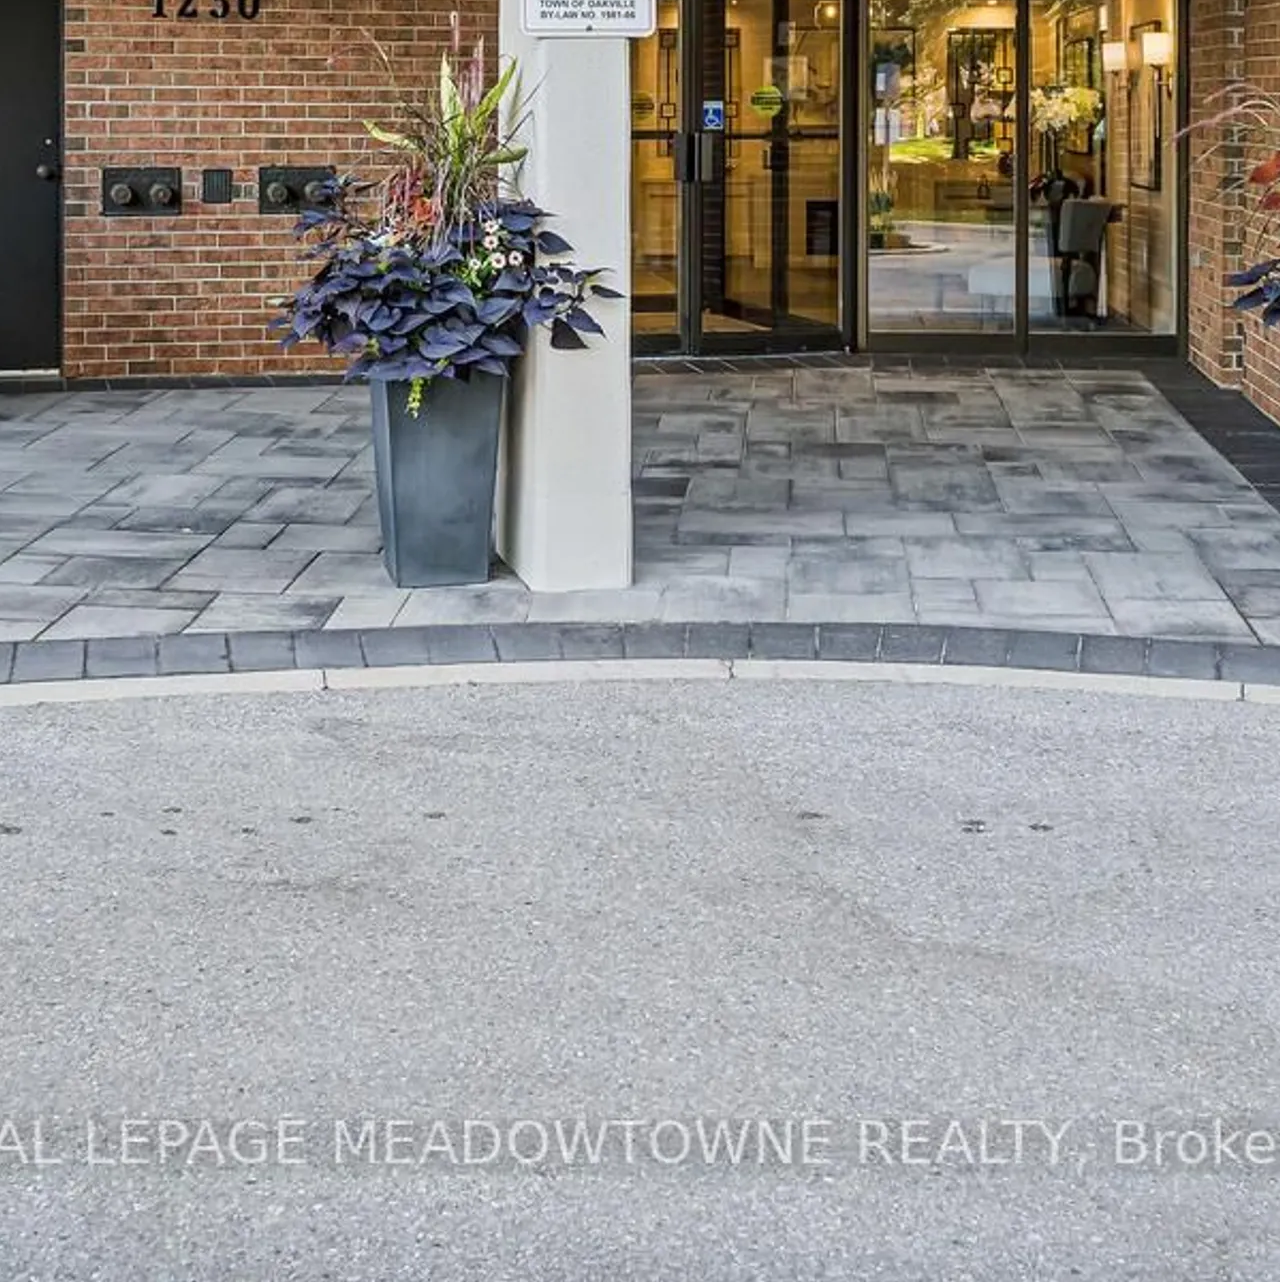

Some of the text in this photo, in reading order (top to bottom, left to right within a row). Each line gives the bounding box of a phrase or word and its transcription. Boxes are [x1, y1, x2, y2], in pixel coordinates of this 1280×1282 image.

[540, 0, 636, 8] TOWN OF OAKVILLE
[540, 10, 579, 19] BY-LAW
